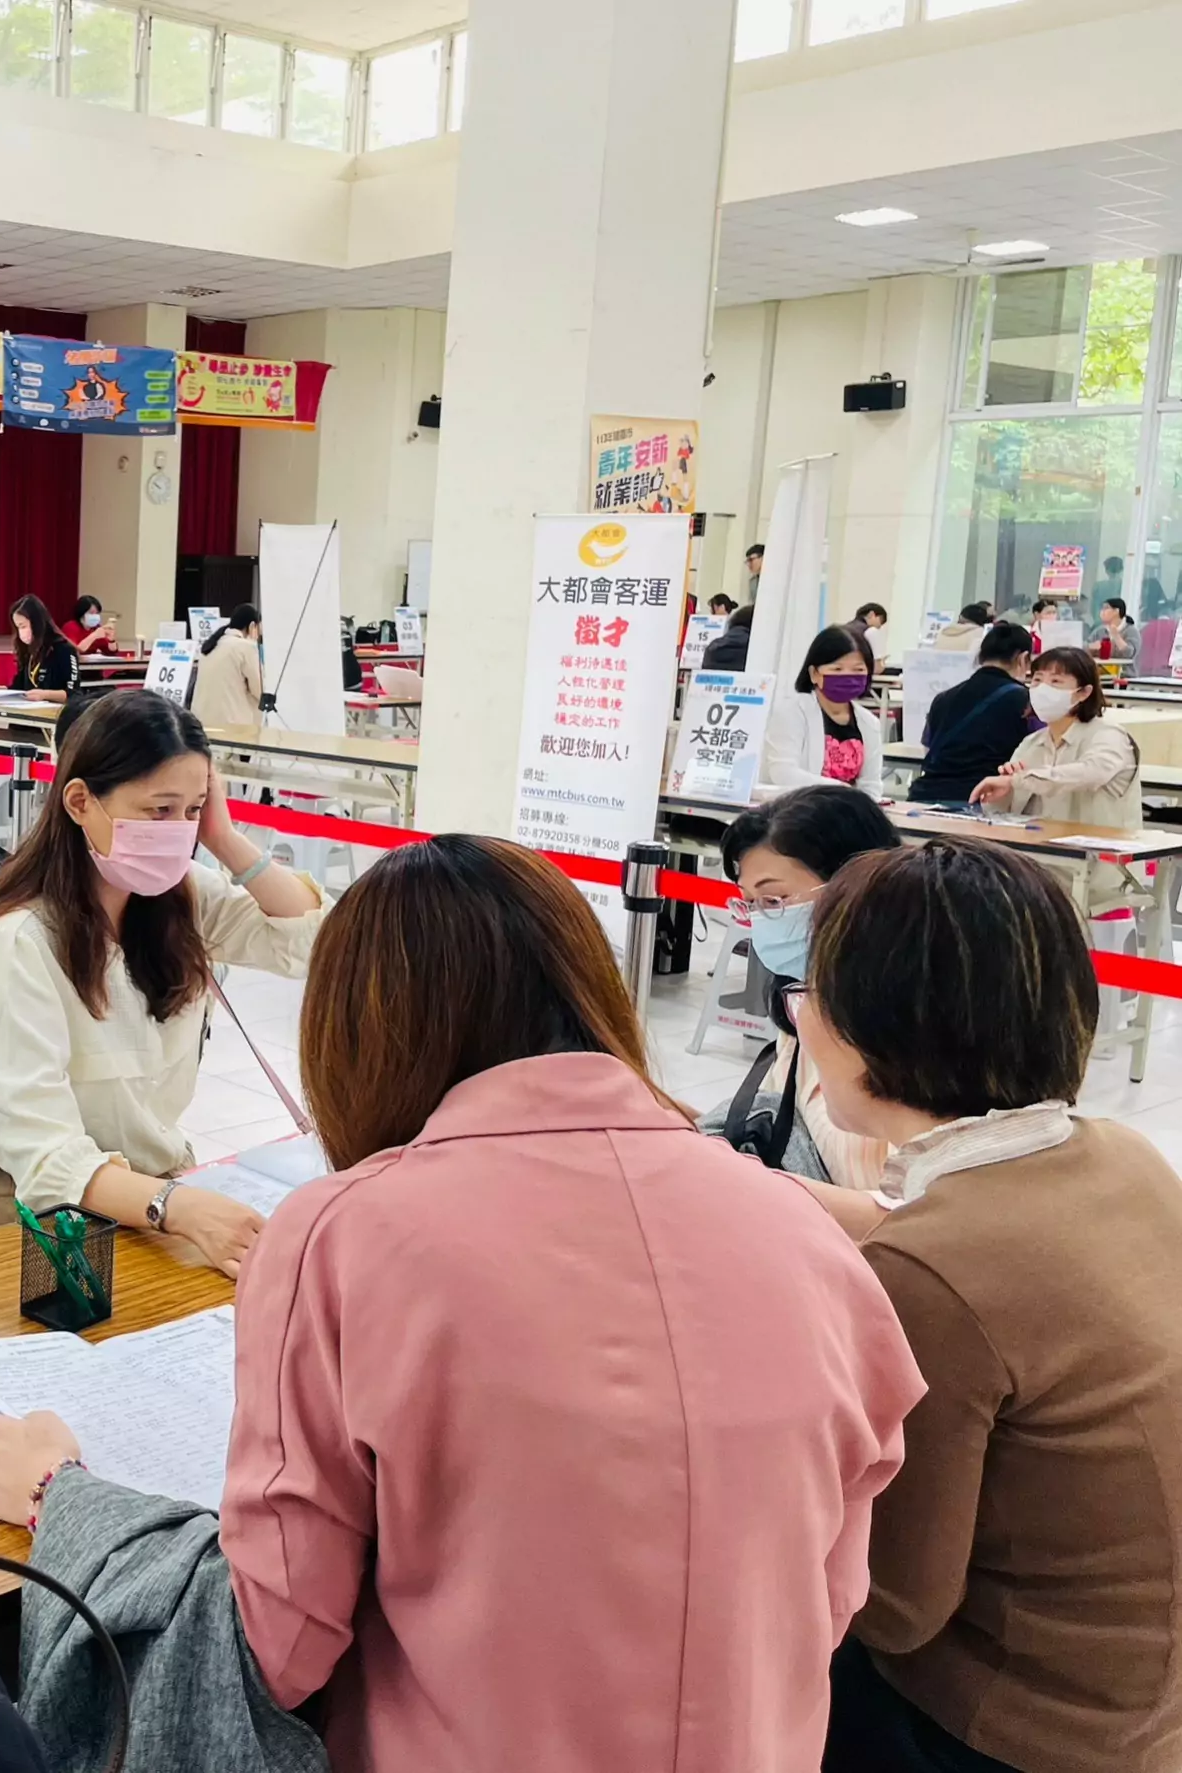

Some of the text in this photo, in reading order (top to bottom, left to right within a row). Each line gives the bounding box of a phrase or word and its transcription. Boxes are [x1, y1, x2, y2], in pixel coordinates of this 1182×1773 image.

[598, 434, 668, 478] 青年安薪
[537, 576, 671, 607] 大都會客運
[198, 620, 211, 630] 02
[574, 615, 630, 648] 徵才
[698, 632, 708, 641] 15
[560, 655, 627, 672] 福利待遇佳
[159, 666, 176, 683] 06
[558, 676, 626, 692] 人性化管理
[556, 692, 623, 711] 良好的環境
[554, 711, 620, 729] 穩定的工作
[706, 703, 740, 726] 07
[540, 734, 630, 761] 歡迎您加入!
[690, 726, 749, 750] 大都會
[696, 747, 736, 769] 客運
[521, 786, 625, 808] www.mtcbus.com.tw
[518, 826, 580, 845] 02-87920358
